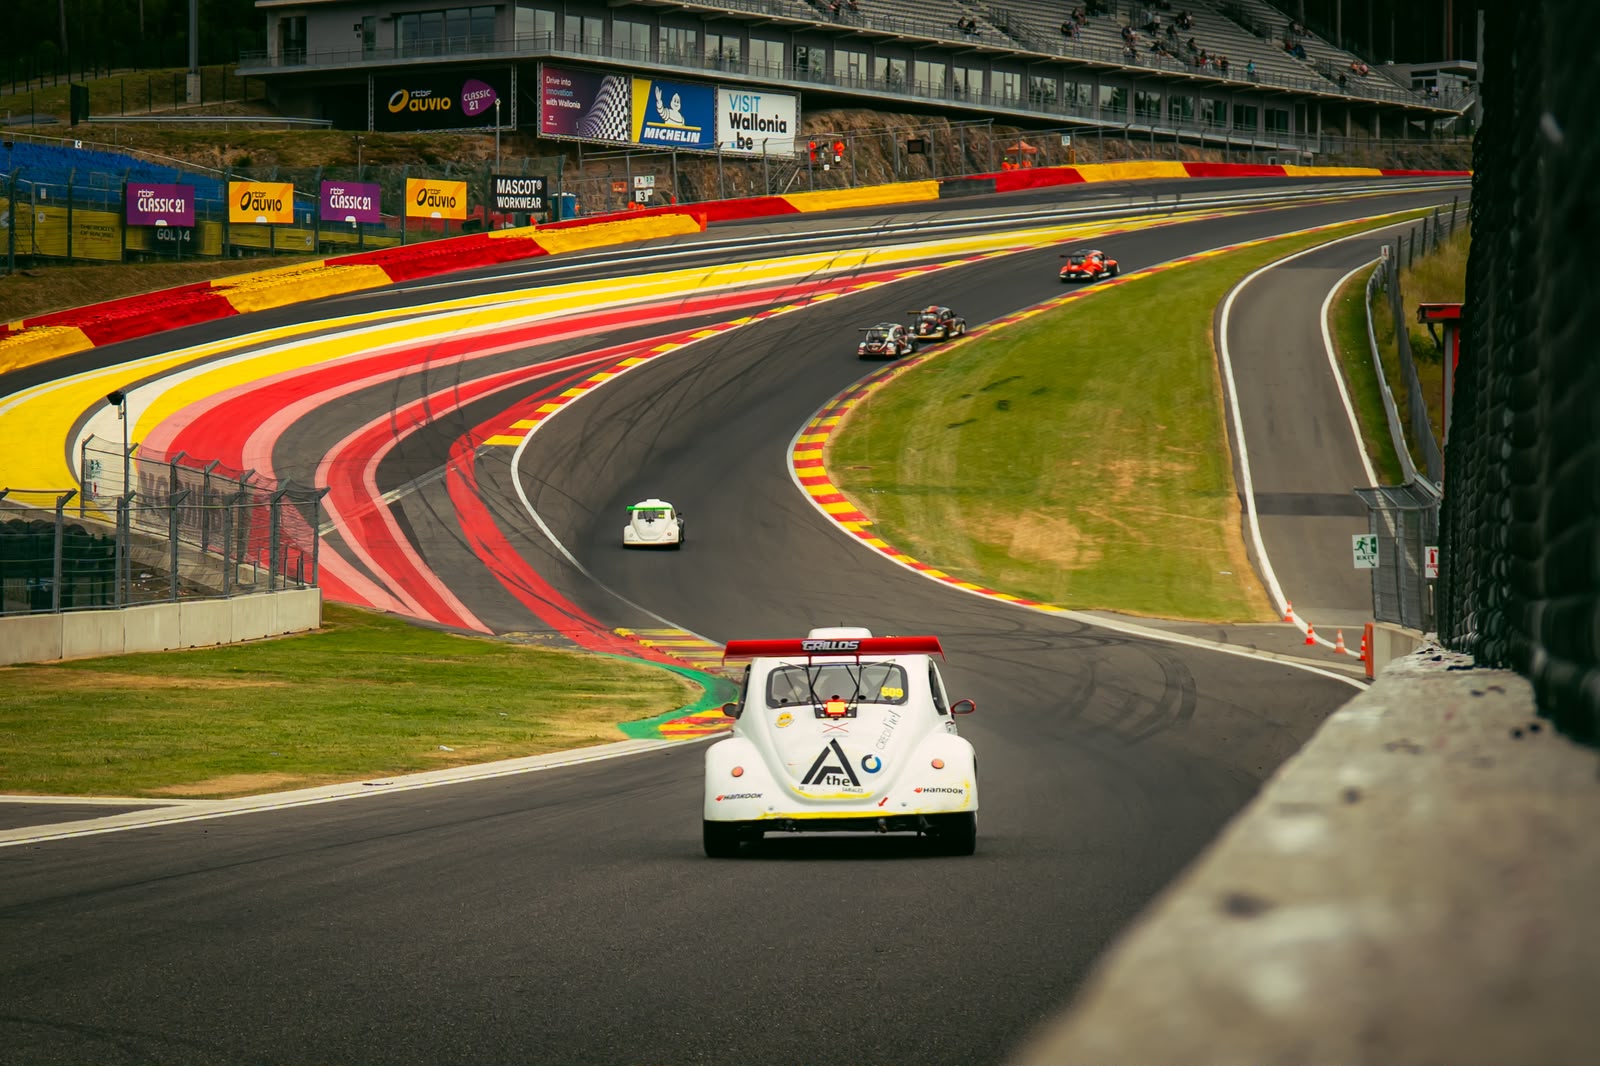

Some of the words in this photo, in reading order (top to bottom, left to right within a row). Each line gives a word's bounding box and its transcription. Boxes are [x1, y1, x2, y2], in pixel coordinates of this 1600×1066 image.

[546, 76, 560, 85] Drive
[463, 89, 491, 102] CLASSIC
[409, 97, 451, 112] auvio
[469, 101, 479, 111] 21
[546, 98, 558, 106] with
[558, 99, 581, 109] Wallonia
[729, 94, 761, 113] VISIT
[729, 112, 787, 134] Wallonia
[643, 127, 701, 144] MICHELIN
[330, 195, 362, 210] CLASSIC
[363, 196, 371, 210] 21
[427, 195, 456, 208] auvio
[497, 196, 541, 209] WORKWEAR
[640, 191, 646, 201] 3
[138, 198, 174, 212] CLASSIC
[175, 199, 185, 213] 21
[252, 199, 282, 211] auvio
[802, 640, 860, 651] GRILLOS
[826, 775, 851, 787] the
